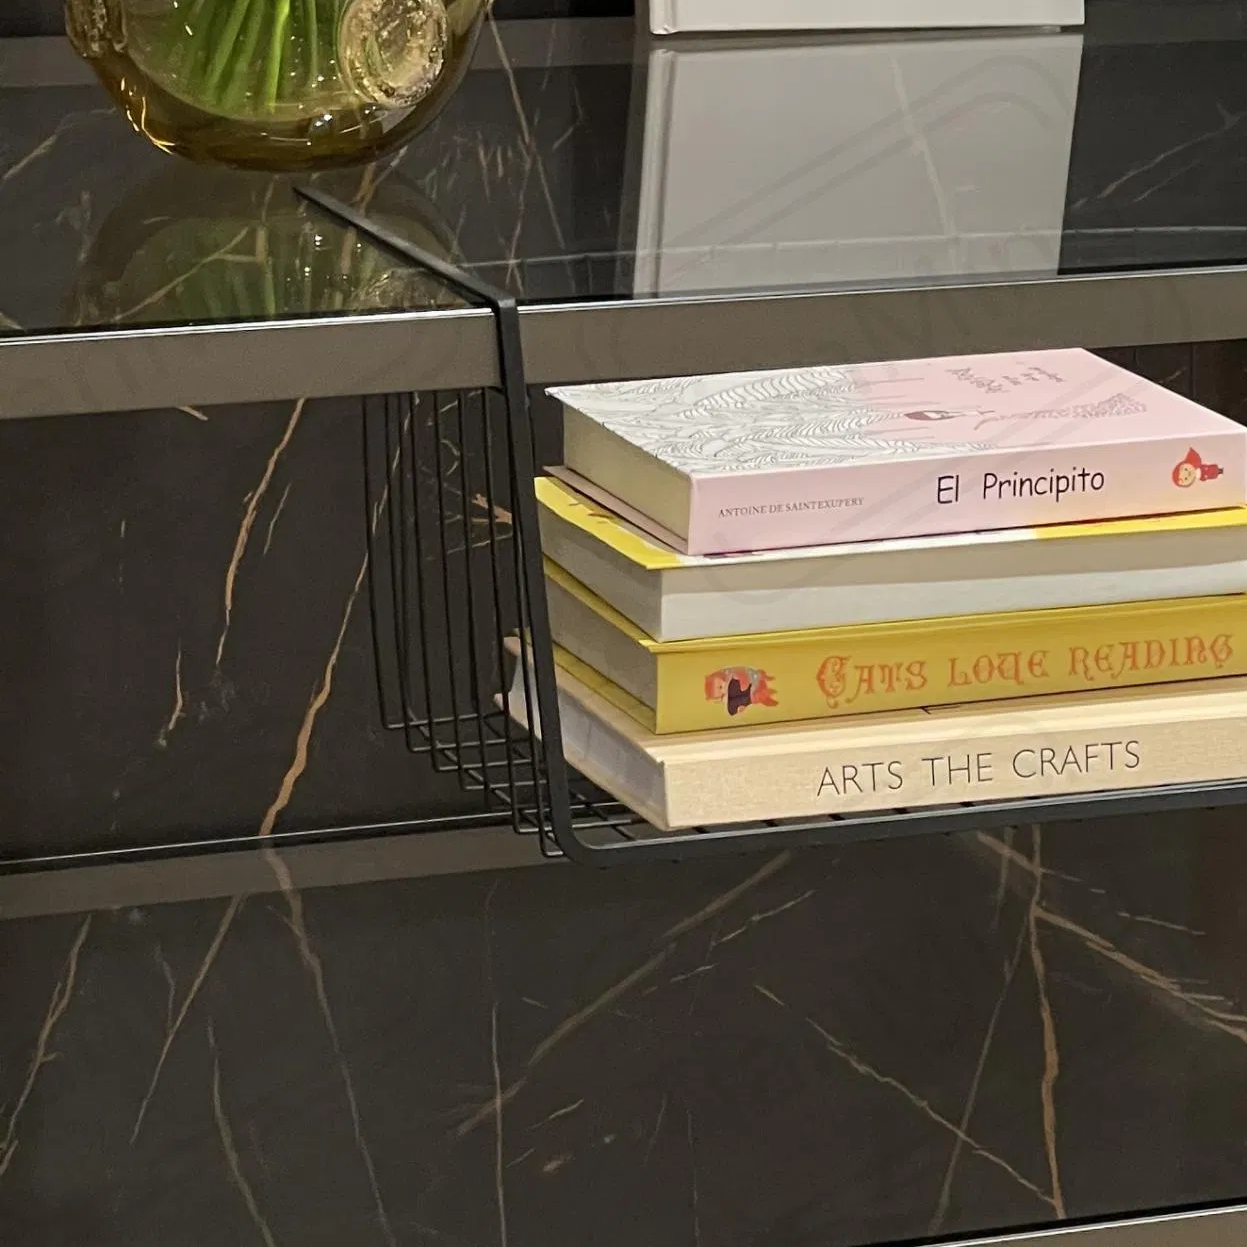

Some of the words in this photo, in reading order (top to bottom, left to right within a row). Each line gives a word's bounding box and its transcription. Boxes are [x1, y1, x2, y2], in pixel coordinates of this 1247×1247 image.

[937, 473, 960, 505] El
[983, 466, 1106, 503] Principito
[718, 504, 768, 519] ANTOINE
[769, 502, 784, 514] DE
[1067, 633, 1235, 682] READING
[816, 760, 904, 797] ARTS
[921, 752, 993, 787] THE
[1012, 740, 1141, 779] CRAFTS
